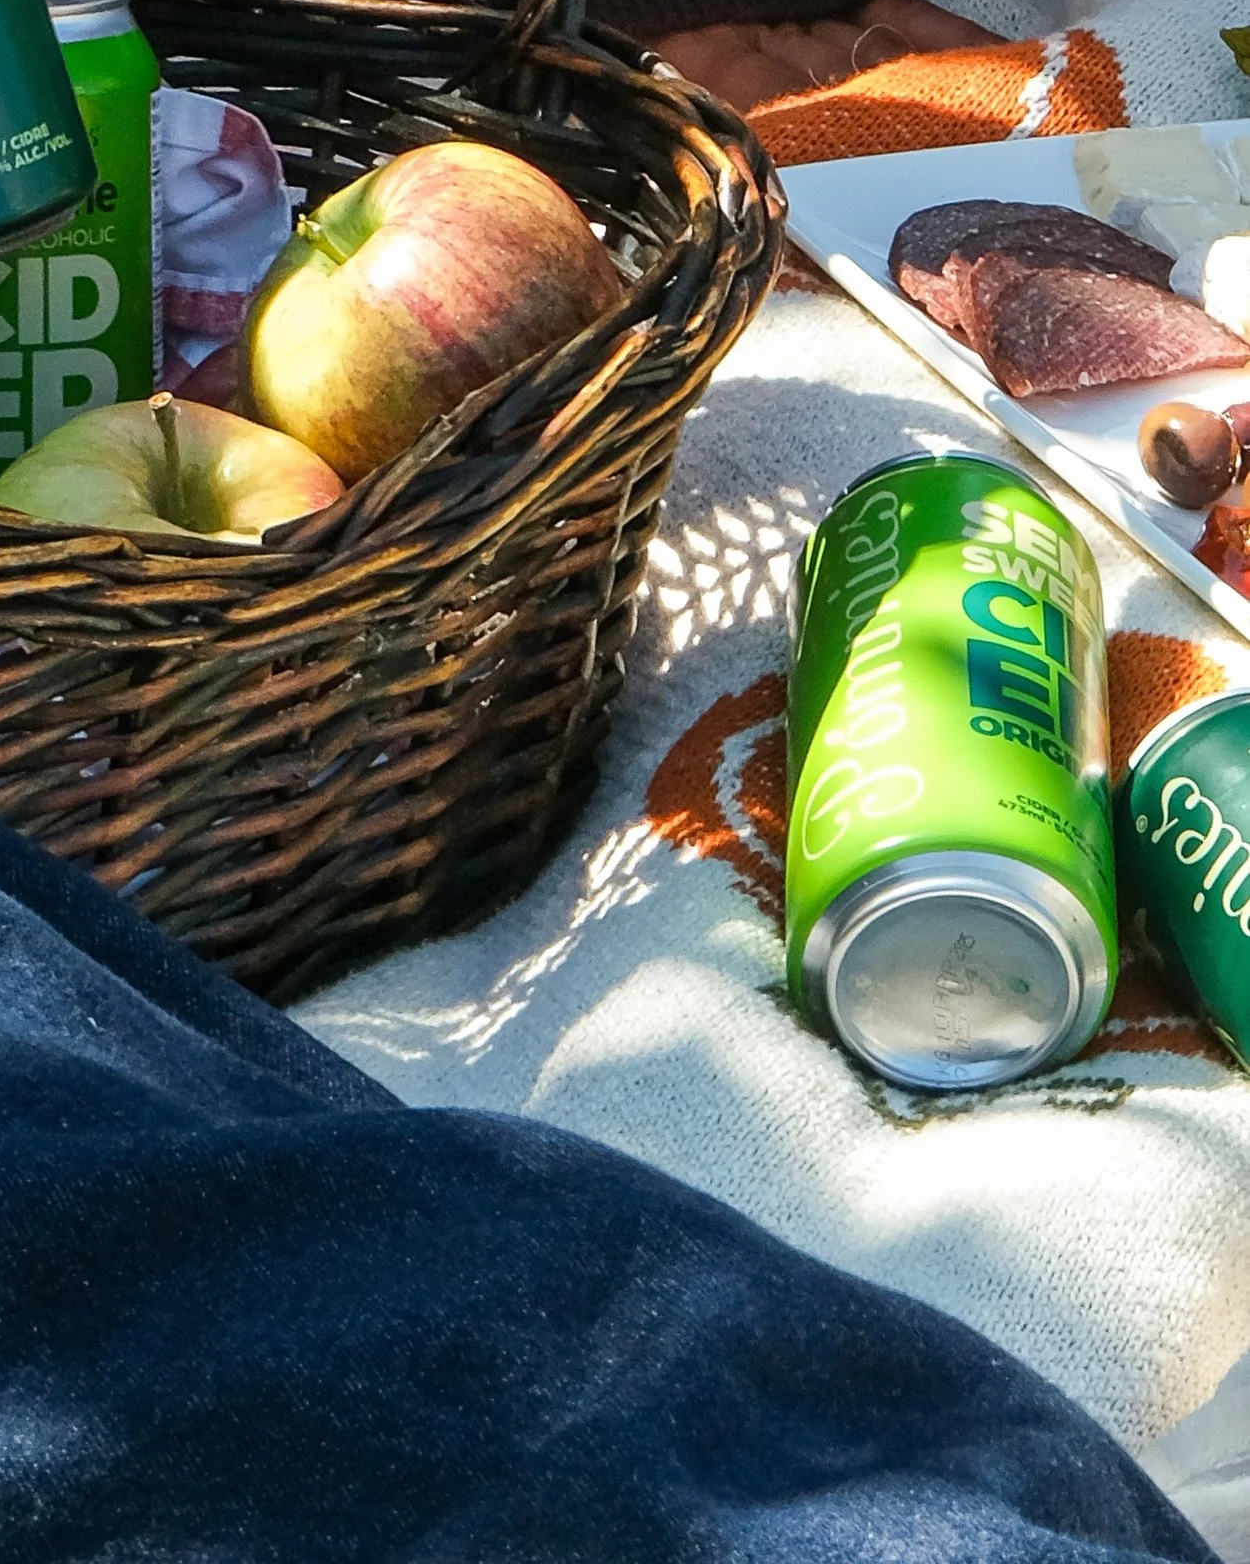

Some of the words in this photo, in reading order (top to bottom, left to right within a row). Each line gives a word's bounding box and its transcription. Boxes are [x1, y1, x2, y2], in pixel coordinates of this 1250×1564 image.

[9, 122, 51, 151] CIDRE
[28, 224, 117, 251] OHOLIC
[961, 580, 1075, 671] CI
[1016, 794, 1061, 823] CIDER
